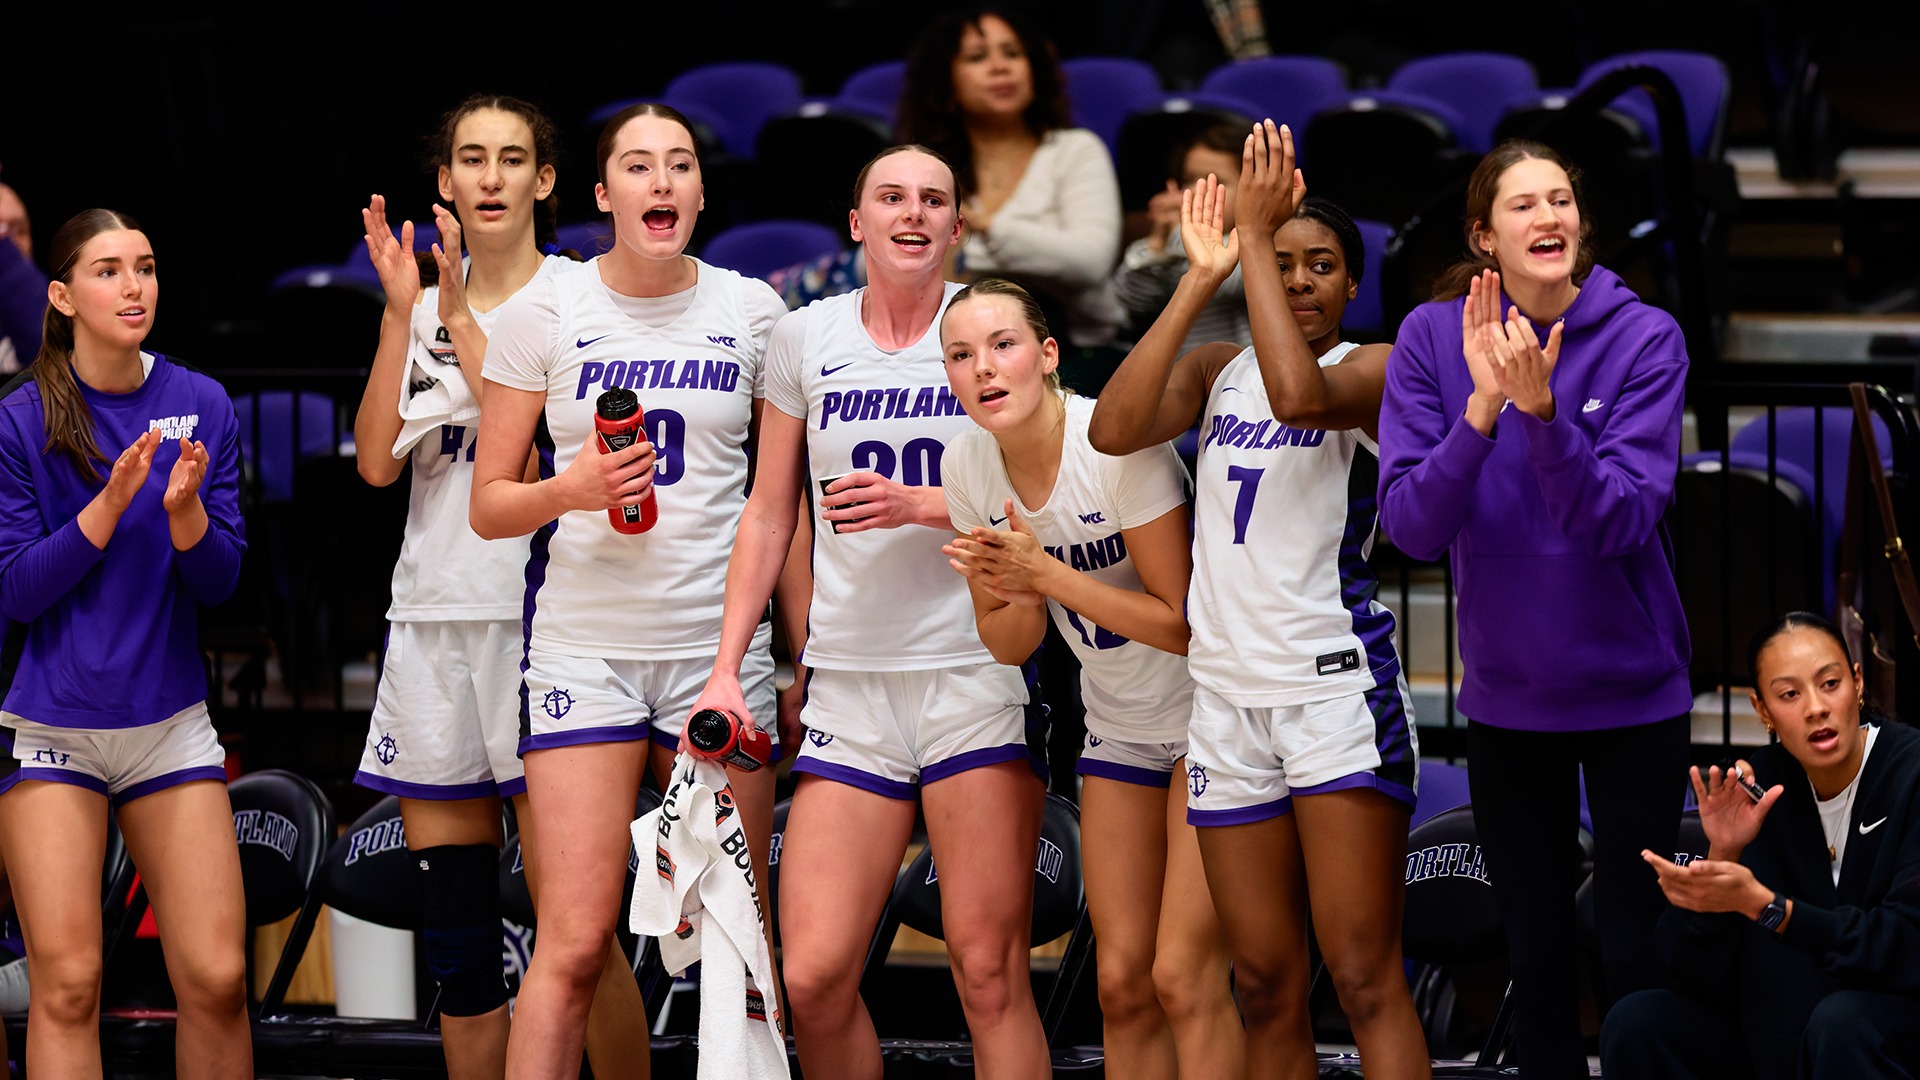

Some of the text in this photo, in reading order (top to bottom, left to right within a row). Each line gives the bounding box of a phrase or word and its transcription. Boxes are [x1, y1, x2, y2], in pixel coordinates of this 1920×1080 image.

[575, 359, 740, 400] PORTLAND
[148, 414, 199, 434] PORTLAND
[160, 426, 193, 443] PILOTS
[1204, 413, 1327, 453] PORTLAND
[643, 408, 686, 486] 9
[851, 437, 946, 487] 20
[1227, 465, 1266, 544] 7
[1345, 655, 1354, 665] M
[233, 809, 299, 861] TLAND
[1405, 843, 1492, 887] ORTLA
